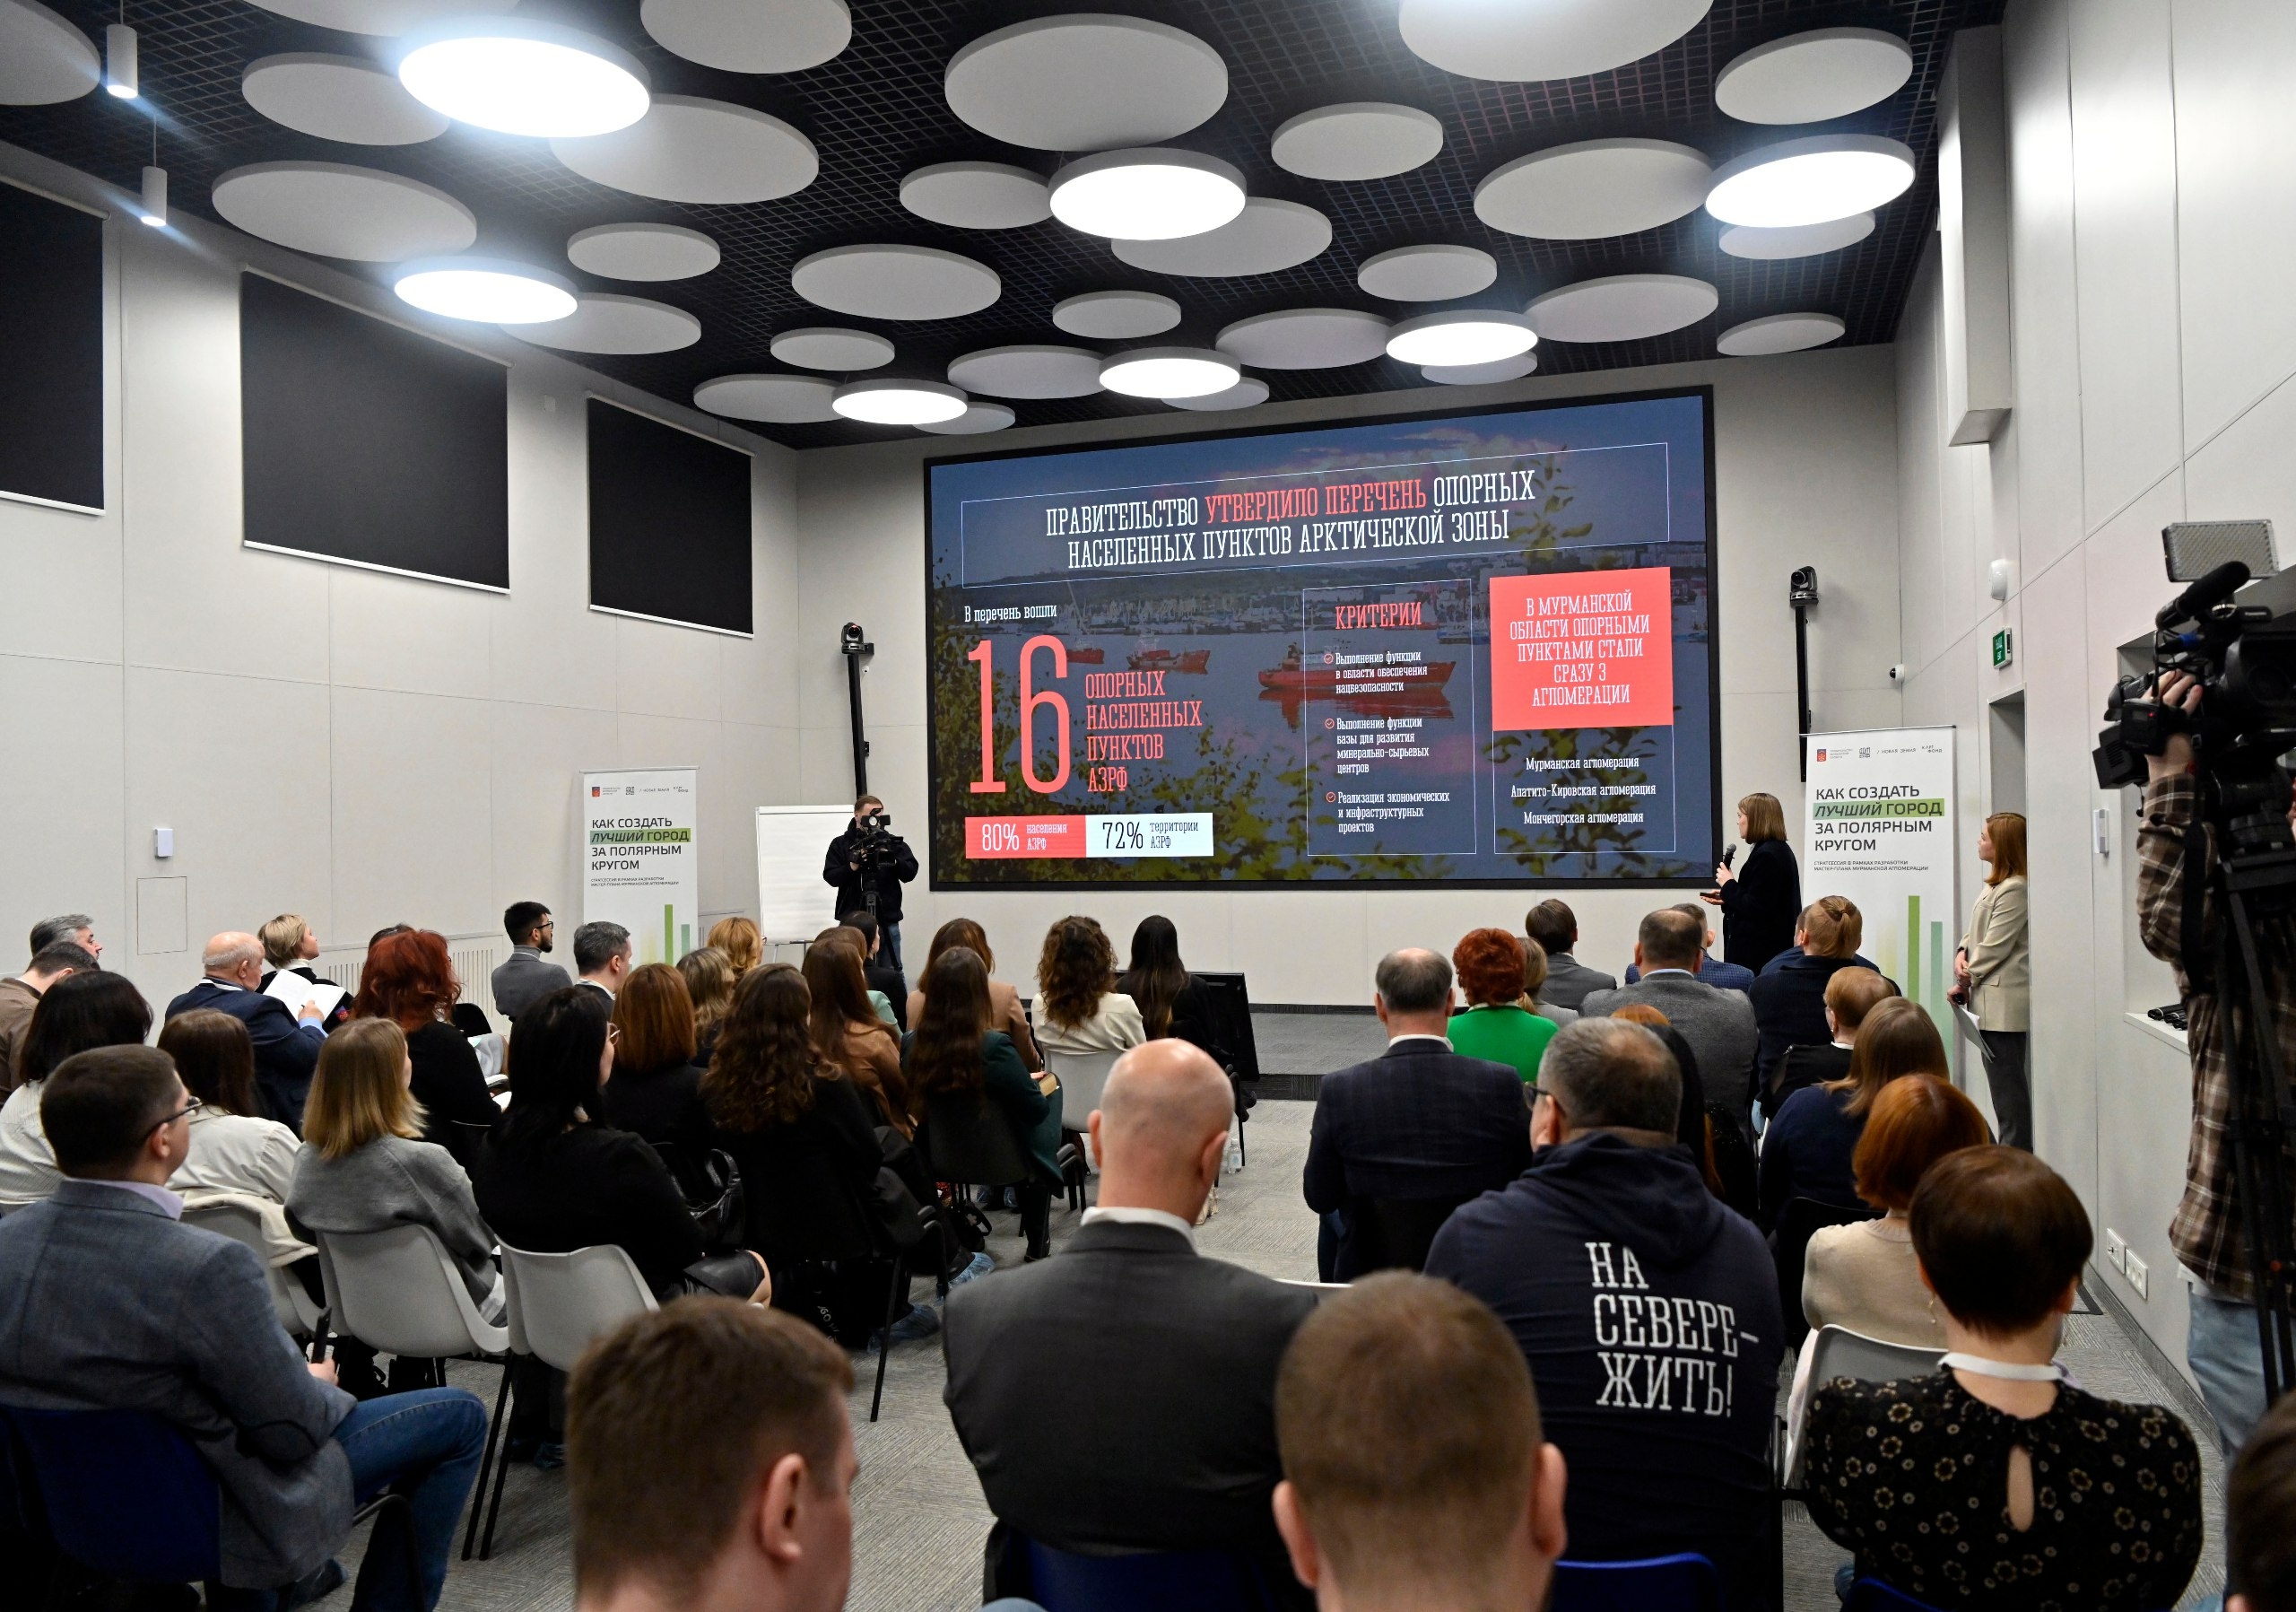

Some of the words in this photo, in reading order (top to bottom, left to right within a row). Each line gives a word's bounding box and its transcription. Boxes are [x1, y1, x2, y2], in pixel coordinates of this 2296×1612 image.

[1046, 497, 1198, 536] ПРАВИТЕЛЬСТВО
[1205, 487, 1318, 524] УТВЕРДИЛО
[1325, 478, 1427, 515] ПЕРЕЧЕНЬ
[1433, 469, 1535, 507] ОПОРНЫХ
[1068, 532, 1196, 569] НАСЕЛЕННЫХ
[1203, 525, 1292, 560] ПУНКТОВ
[1299, 510, 1444, 553] АРКТИЧЕСКОЙ
[1451, 509, 1509, 543] ЗОНЫ
[1526, 598, 1534, 616] В
[1539, 589, 1632, 615] МУРМАНСКОЙ
[964, 606, 970, 622] В
[974, 606, 1021, 623] перечень
[1024, 606, 1057, 619] вошли
[1335, 602, 1422, 630] КРИТЕРИИ
[1510, 619, 1569, 640] ОБЛАСТИ
[1573, 614, 1649, 637] ОПОРНЫМИ
[1518, 640, 1593, 661] ПУНКТАМИ
[1598, 638, 1643, 658] СТАЛИ
[1335, 653, 1383, 665] Выполнение
[1387, 651, 1421, 664] функции
[1336, 670, 1340, 679] в
[1344, 668, 1374, 679] области
[1378, 666, 1427, 677] обеспечения
[1554, 663, 1594, 683] СРАЗУ
[1599, 663, 1605, 681] 3
[1085, 671, 1165, 699] ОПОРНЫХ
[1336, 682, 1404, 694] нацбезопасности
[1533, 684, 1630, 706] АГЛОМЕРАЦИИ
[969, 635, 1070, 793] 16
[1086, 701, 1202, 730] НАСЕЛЕННЫХ
[1337, 718, 1384, 730] Выполнение
[1387, 717, 1422, 730] функции
[1337, 735, 1357, 744] базы
[1360, 735, 1373, 744] для
[1377, 733, 1414, 745] развития
[1087, 734, 1163, 761] ПУНКТОВ
[1337, 747, 1429, 760] минерально-сырьевых
[1338, 763, 1369, 775] центров
[1526, 758, 1580, 771] Мурманская
[1584, 758, 1639, 770] агломерация
[1088, 767, 1126, 792] АЗРФ
[1338, 792, 1384, 804] Реализация
[1387, 792, 1449, 802] экономических
[1511, 784, 1596, 798] Апатито-Кировская
[1600, 784, 1656, 797] агломерация
[1816, 788, 1844, 800] КАК
[1849, 786, 1919, 799] СОЗДАТЬ
[1338, 809, 1343, 817] и
[1346, 806, 1423, 820] инфраструктурных
[1815, 802, 1882, 817] ЛУЧШИЙ
[1887, 802, 1942, 815] ГОРОД
[592, 819, 614, 829] КАК
[618, 817, 672, 829] СОЗДАТЬ
[1524, 812, 1585, 825] Мончегорская
[1587, 813, 1643, 824] агломерация
[1027, 823, 1067, 834] населения
[1150, 821, 1198, 833] территории
[1338, 823, 1374, 834] проектов
[1815, 823, 1833, 834] ЗА
[1839, 821, 1932, 833] ПОЛЯРНЫМ
[591, 831, 644, 842] ЛУЧШИЙ
[647, 831, 689, 841] ГОРОД
[982, 823, 1019, 851] 80%
[1102, 822, 1144, 850] 72%
[1151, 836, 1171, 849] АЗРФ
[1027, 837, 1047, 850] АЗРФ
[1815, 839, 1875, 851] КРУГОМ
[591, 847, 606, 857] ЗА
[610, 845, 682, 856] ПОЛЯРНЫМ
[591, 860, 639, 870] КРУГОМ
[1585, 1242, 1650, 1289] НА
[1596, 1352, 1733, 1417] ЖИТЬ!
